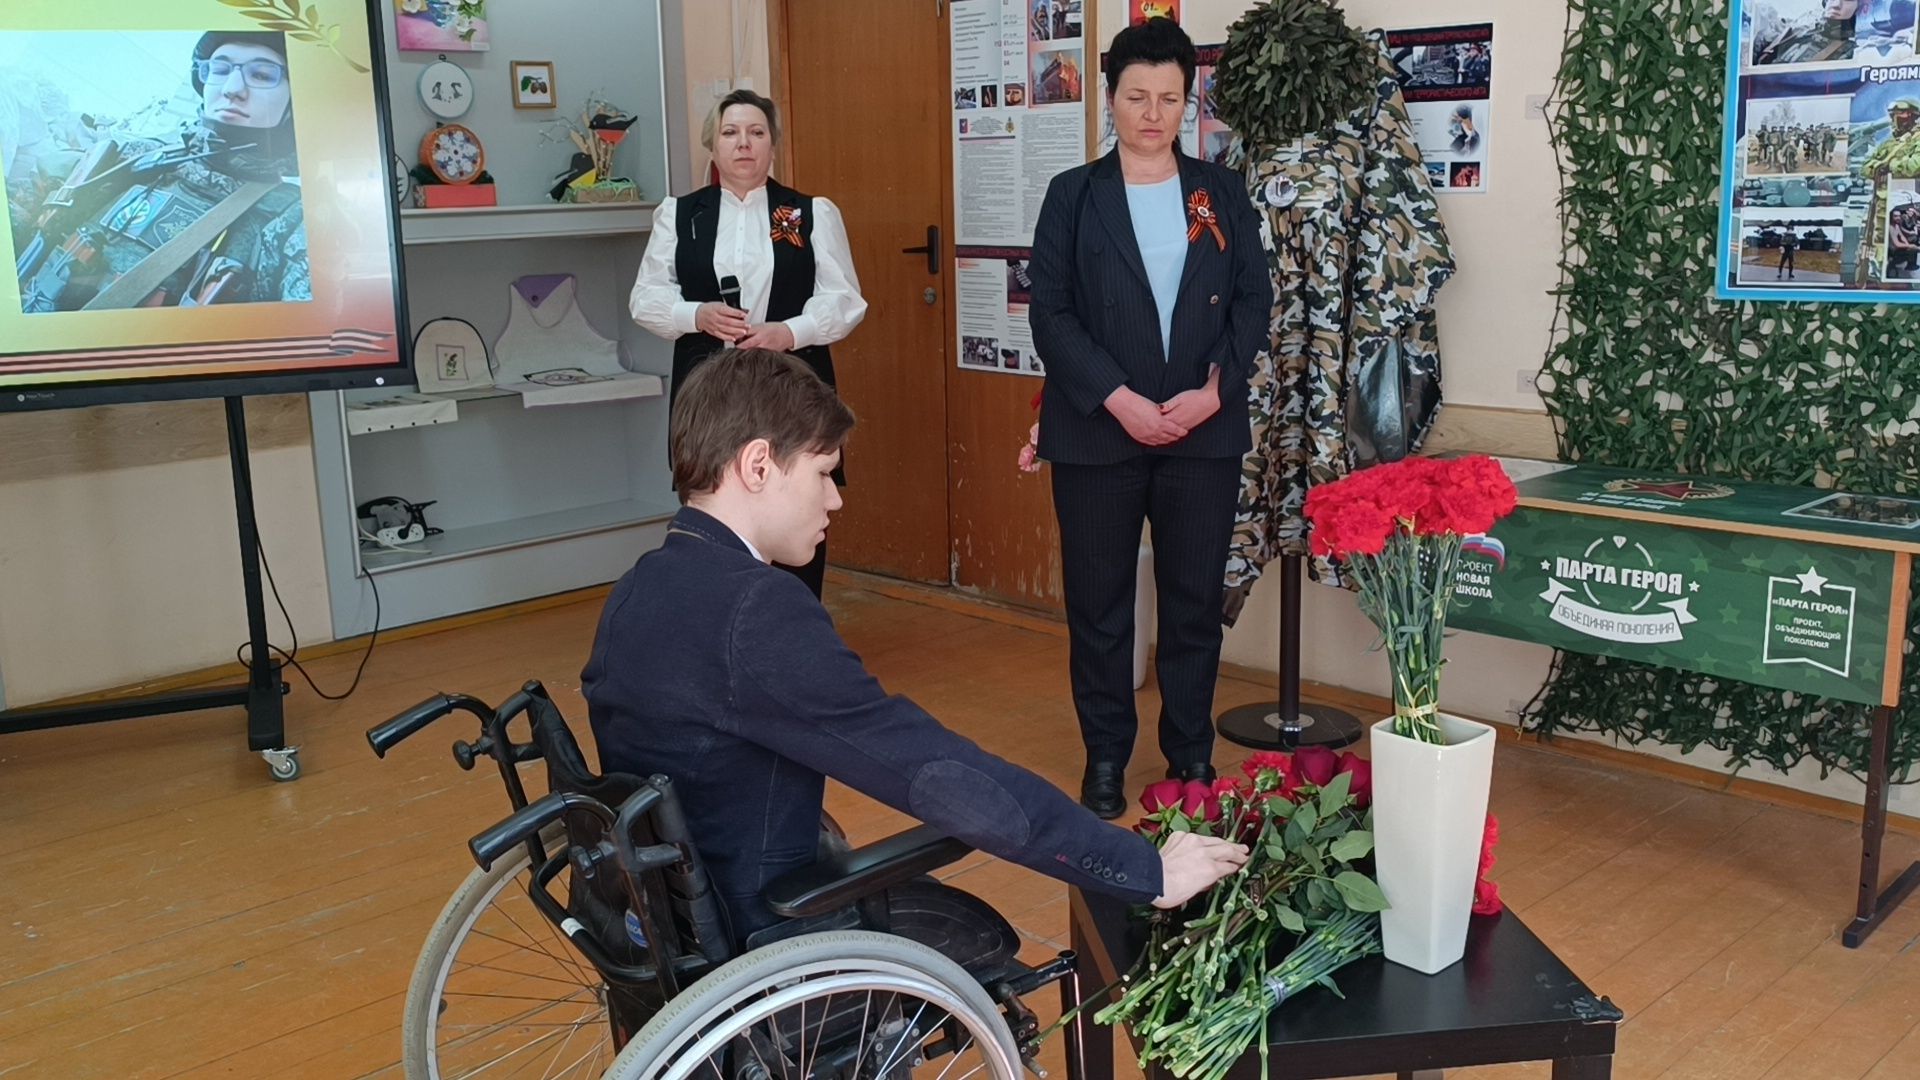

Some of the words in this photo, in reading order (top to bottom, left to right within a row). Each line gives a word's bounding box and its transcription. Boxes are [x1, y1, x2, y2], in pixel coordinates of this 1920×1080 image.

[1860, 66, 1920, 84] Героям
[1456, 572, 1491, 585] НОВАЯ
[1556, 557, 1617, 584] ПАРТА
[1621, 568, 1683, 595] ГЕРОЯ
[1455, 584, 1493, 599] ШКОЛА
